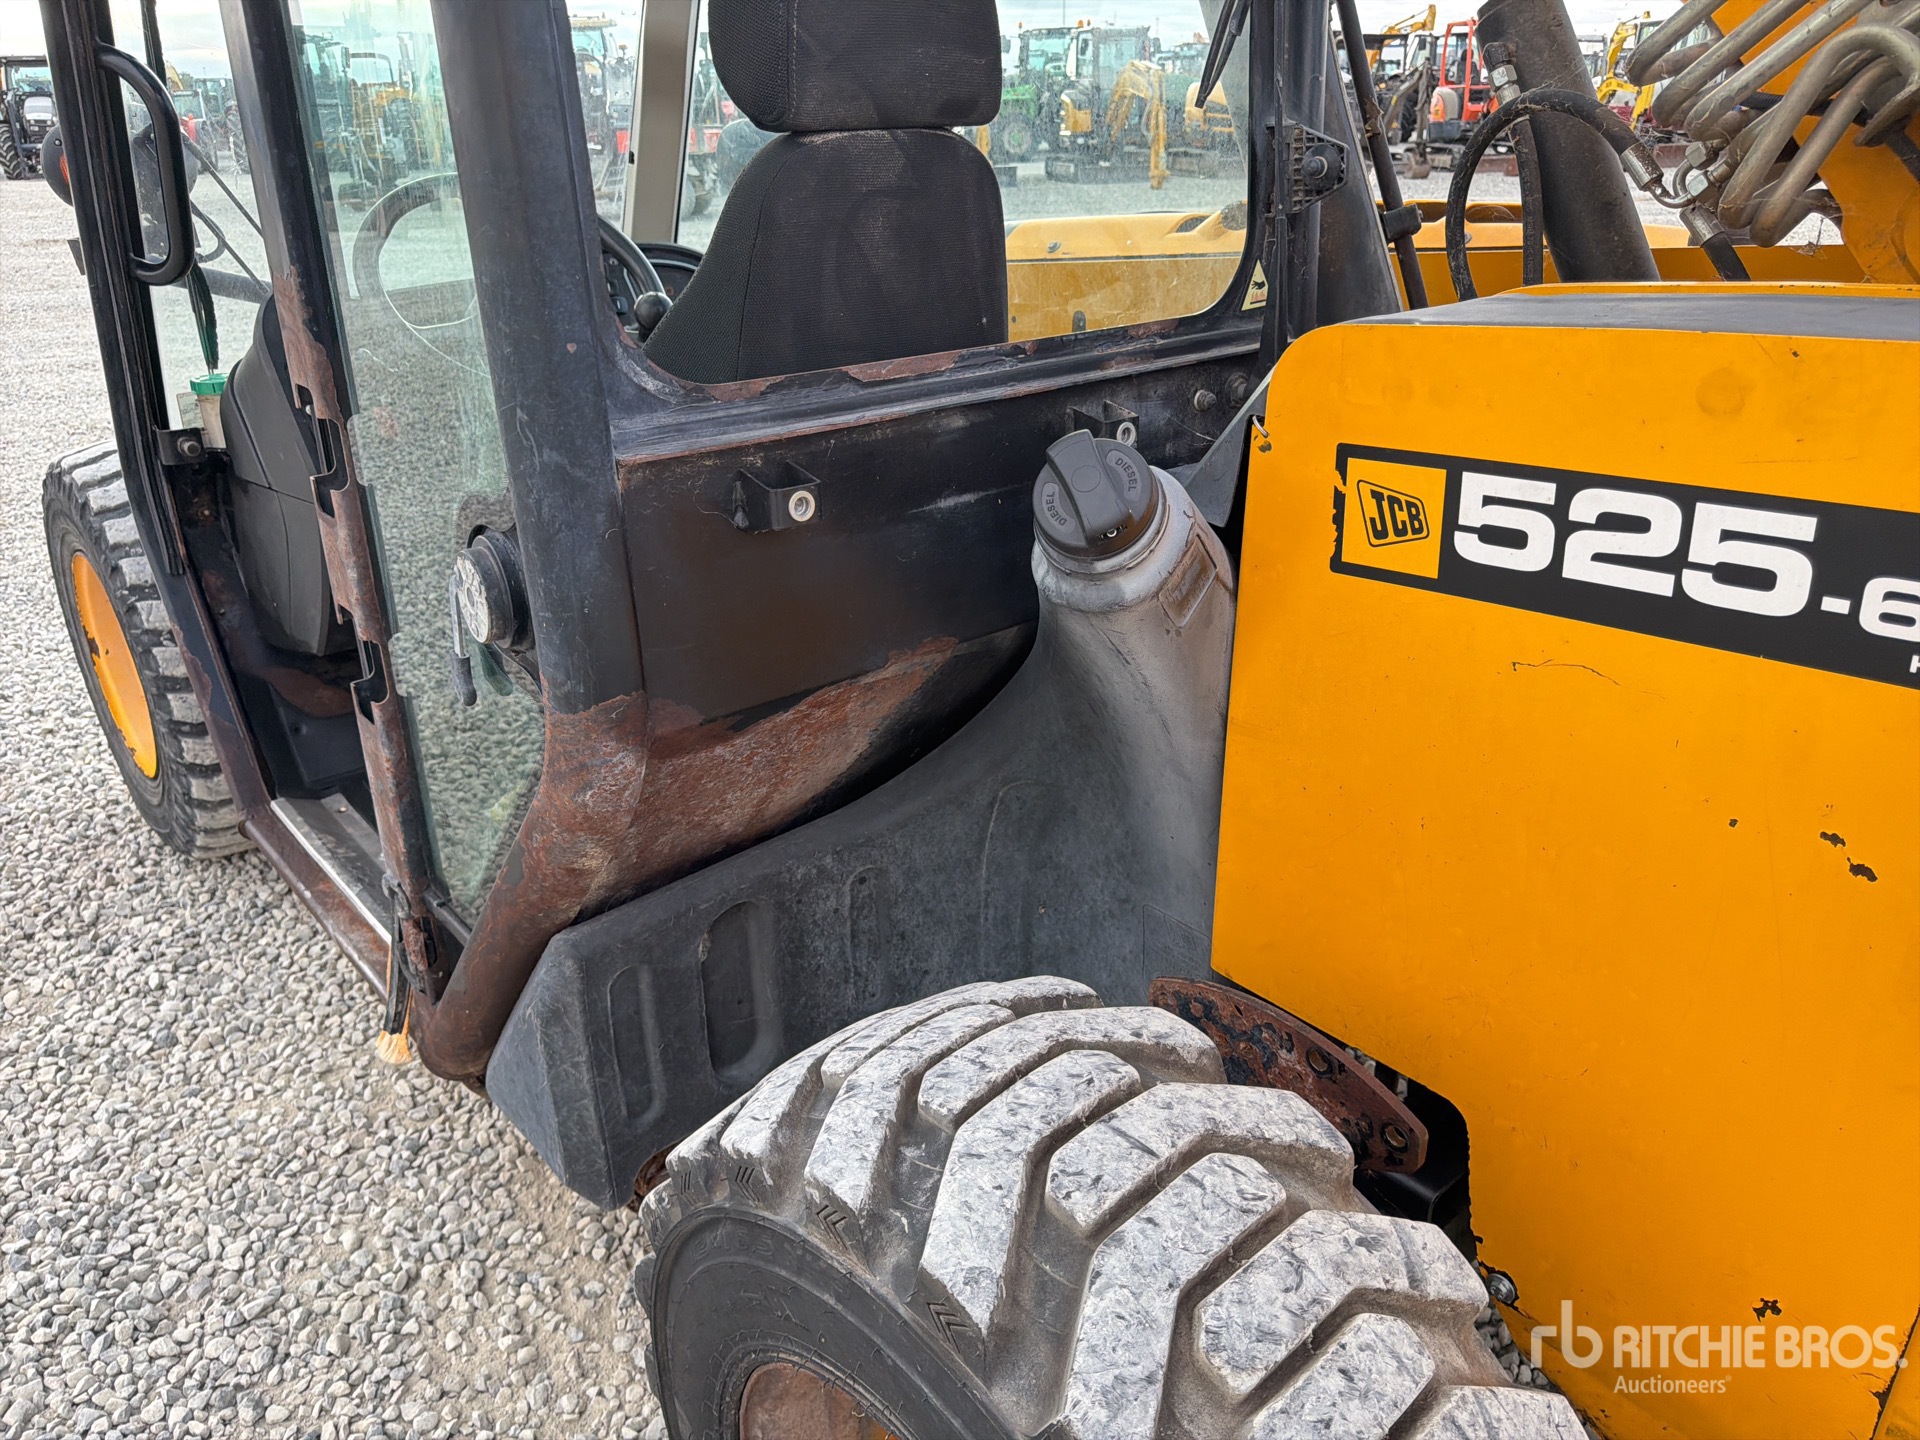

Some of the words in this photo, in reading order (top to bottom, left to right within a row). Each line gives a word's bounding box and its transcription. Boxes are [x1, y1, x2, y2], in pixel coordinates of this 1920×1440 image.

[1114, 457, 1137, 493] DIESEL
[1045, 491, 1068, 527] DIESEL
[1368, 488, 1424, 541] JCB
